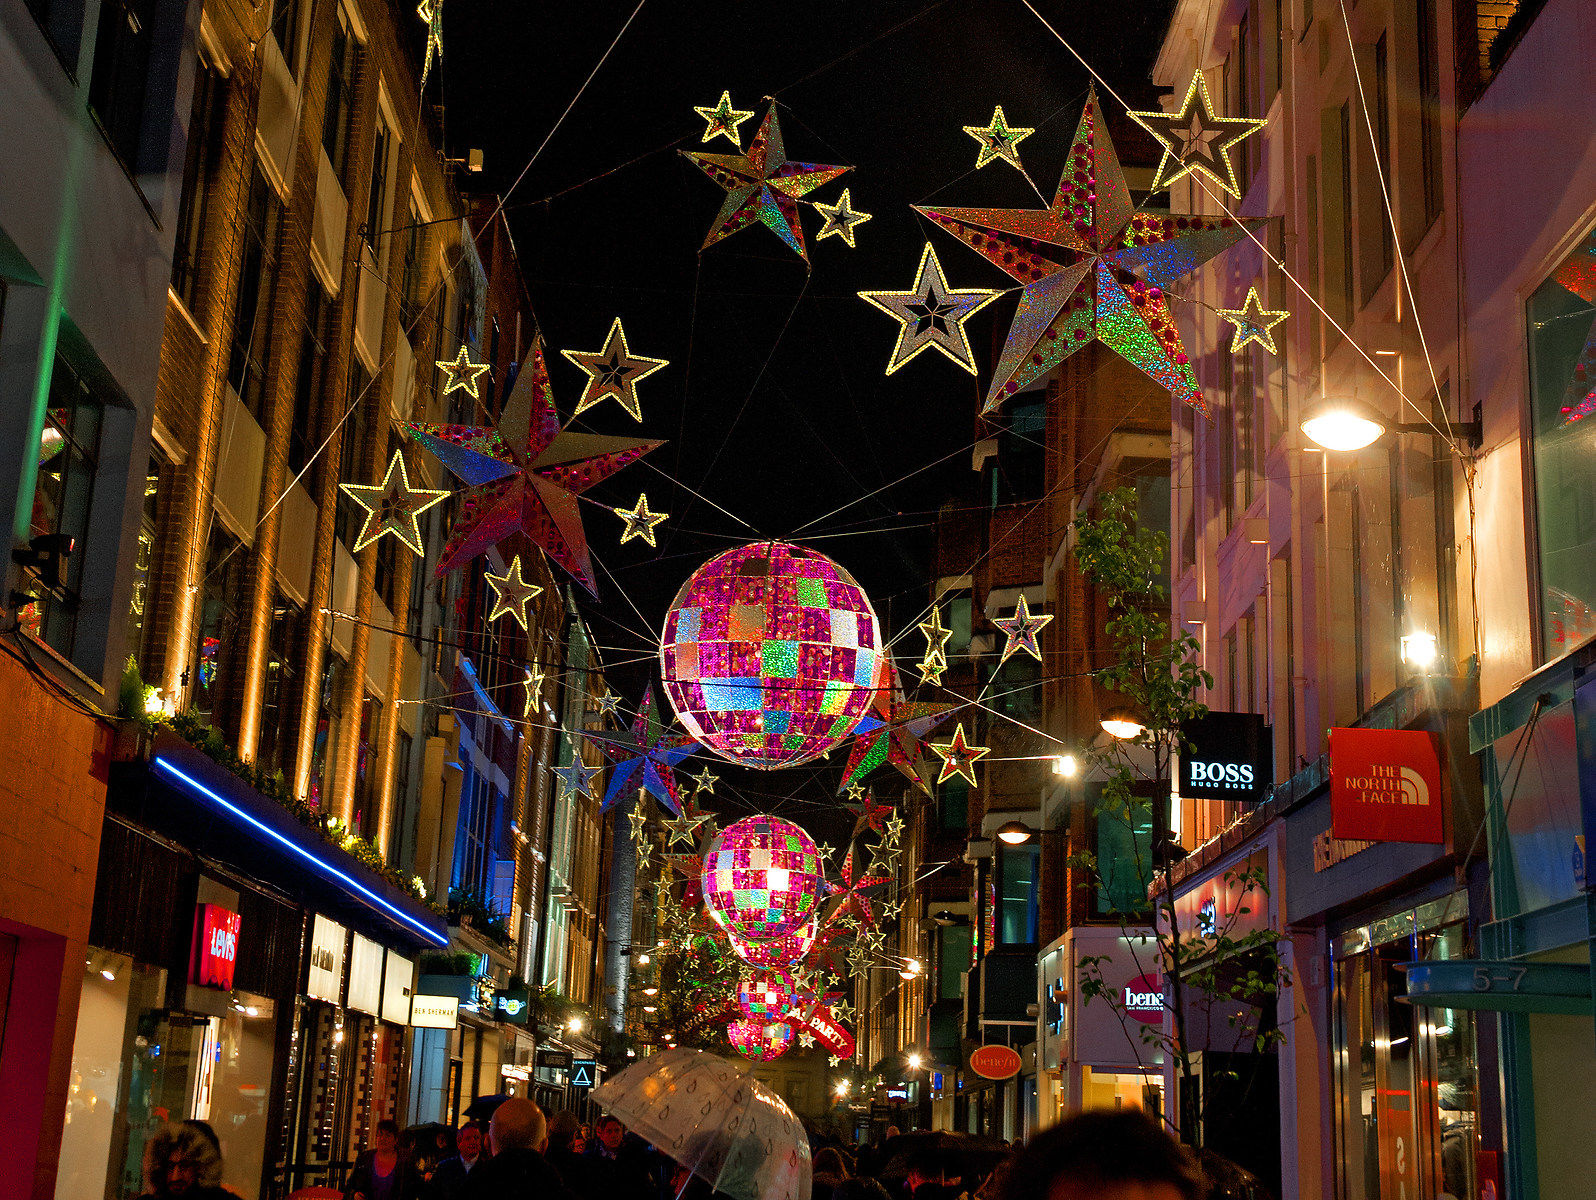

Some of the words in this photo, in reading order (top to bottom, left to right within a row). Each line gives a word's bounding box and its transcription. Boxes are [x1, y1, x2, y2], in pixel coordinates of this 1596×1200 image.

[1190, 761, 1254, 784] BOSS
[1371, 765, 1399, 778] THE
[1225, 782, 1253, 790] BOSS
[1345, 777, 1401, 791] NORTH
[1360, 791, 1399, 804] FACE
[427, 1008, 455, 1016] SHERMAN
[809, 1016, 848, 1049] PARTY
